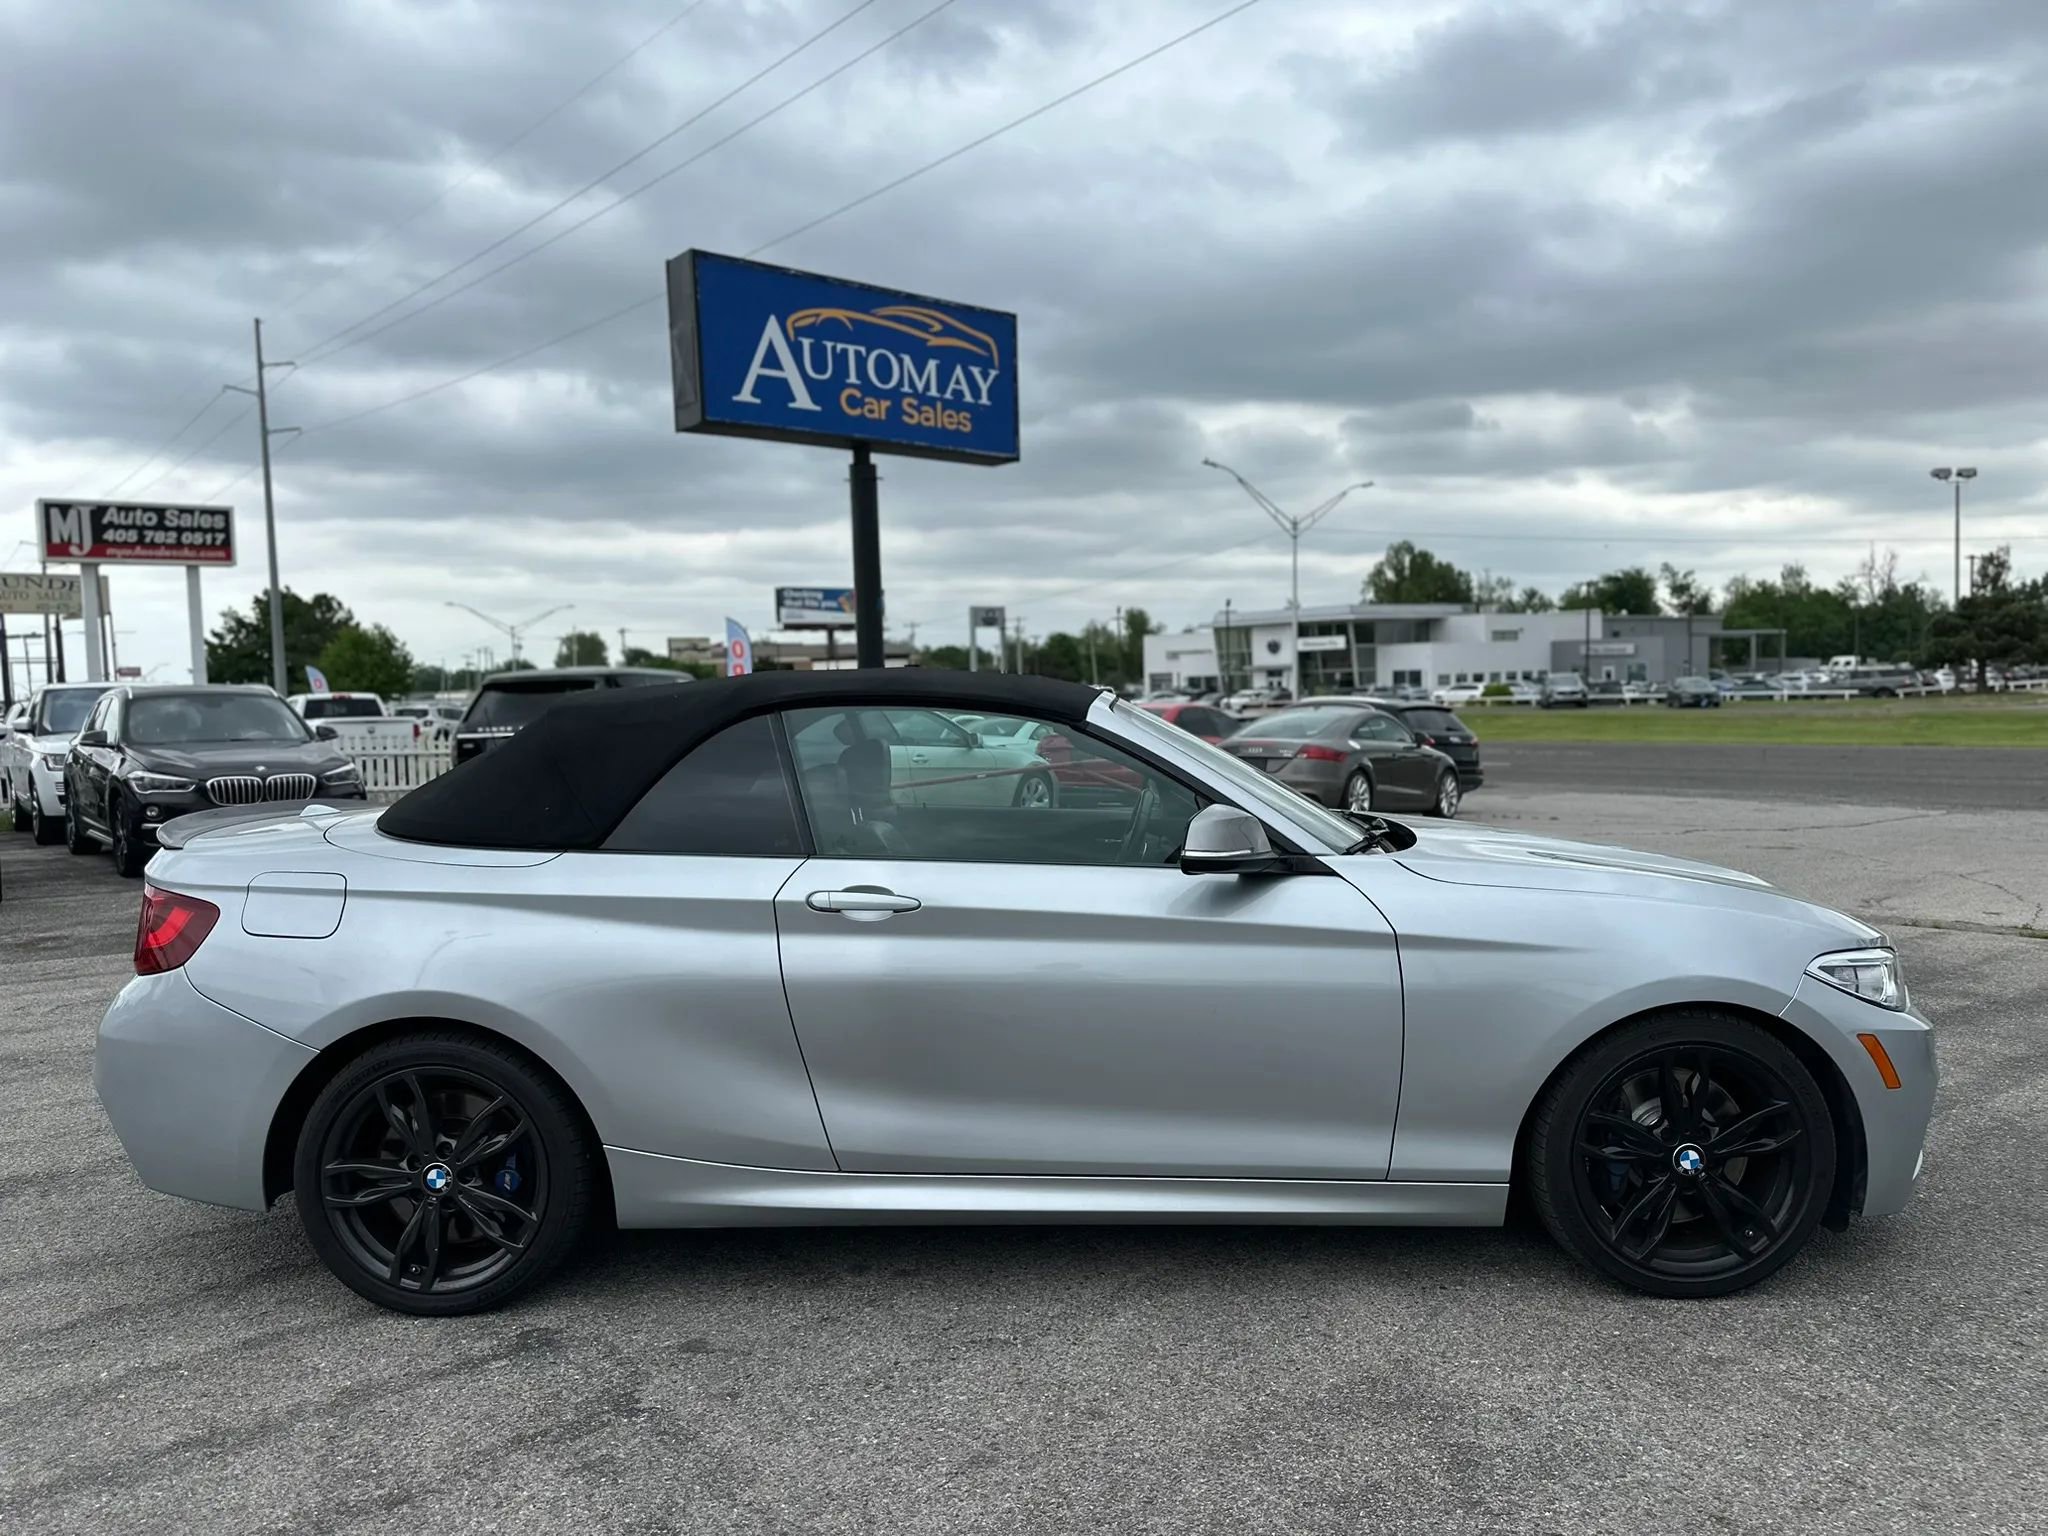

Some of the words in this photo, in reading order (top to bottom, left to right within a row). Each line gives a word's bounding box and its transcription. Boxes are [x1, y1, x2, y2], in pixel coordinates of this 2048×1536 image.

[731, 314, 999, 411] AUTOMAY
[839, 388, 891, 420] Car
[901, 397, 972, 433] Sales
[50, 505, 97, 556] MJ
[102, 507, 158, 528] Auto
[164, 509, 226, 529] Sales
[102, 528, 139, 543] 405
[143, 530, 178, 544] 782
[181, 532, 226, 546] 0517
